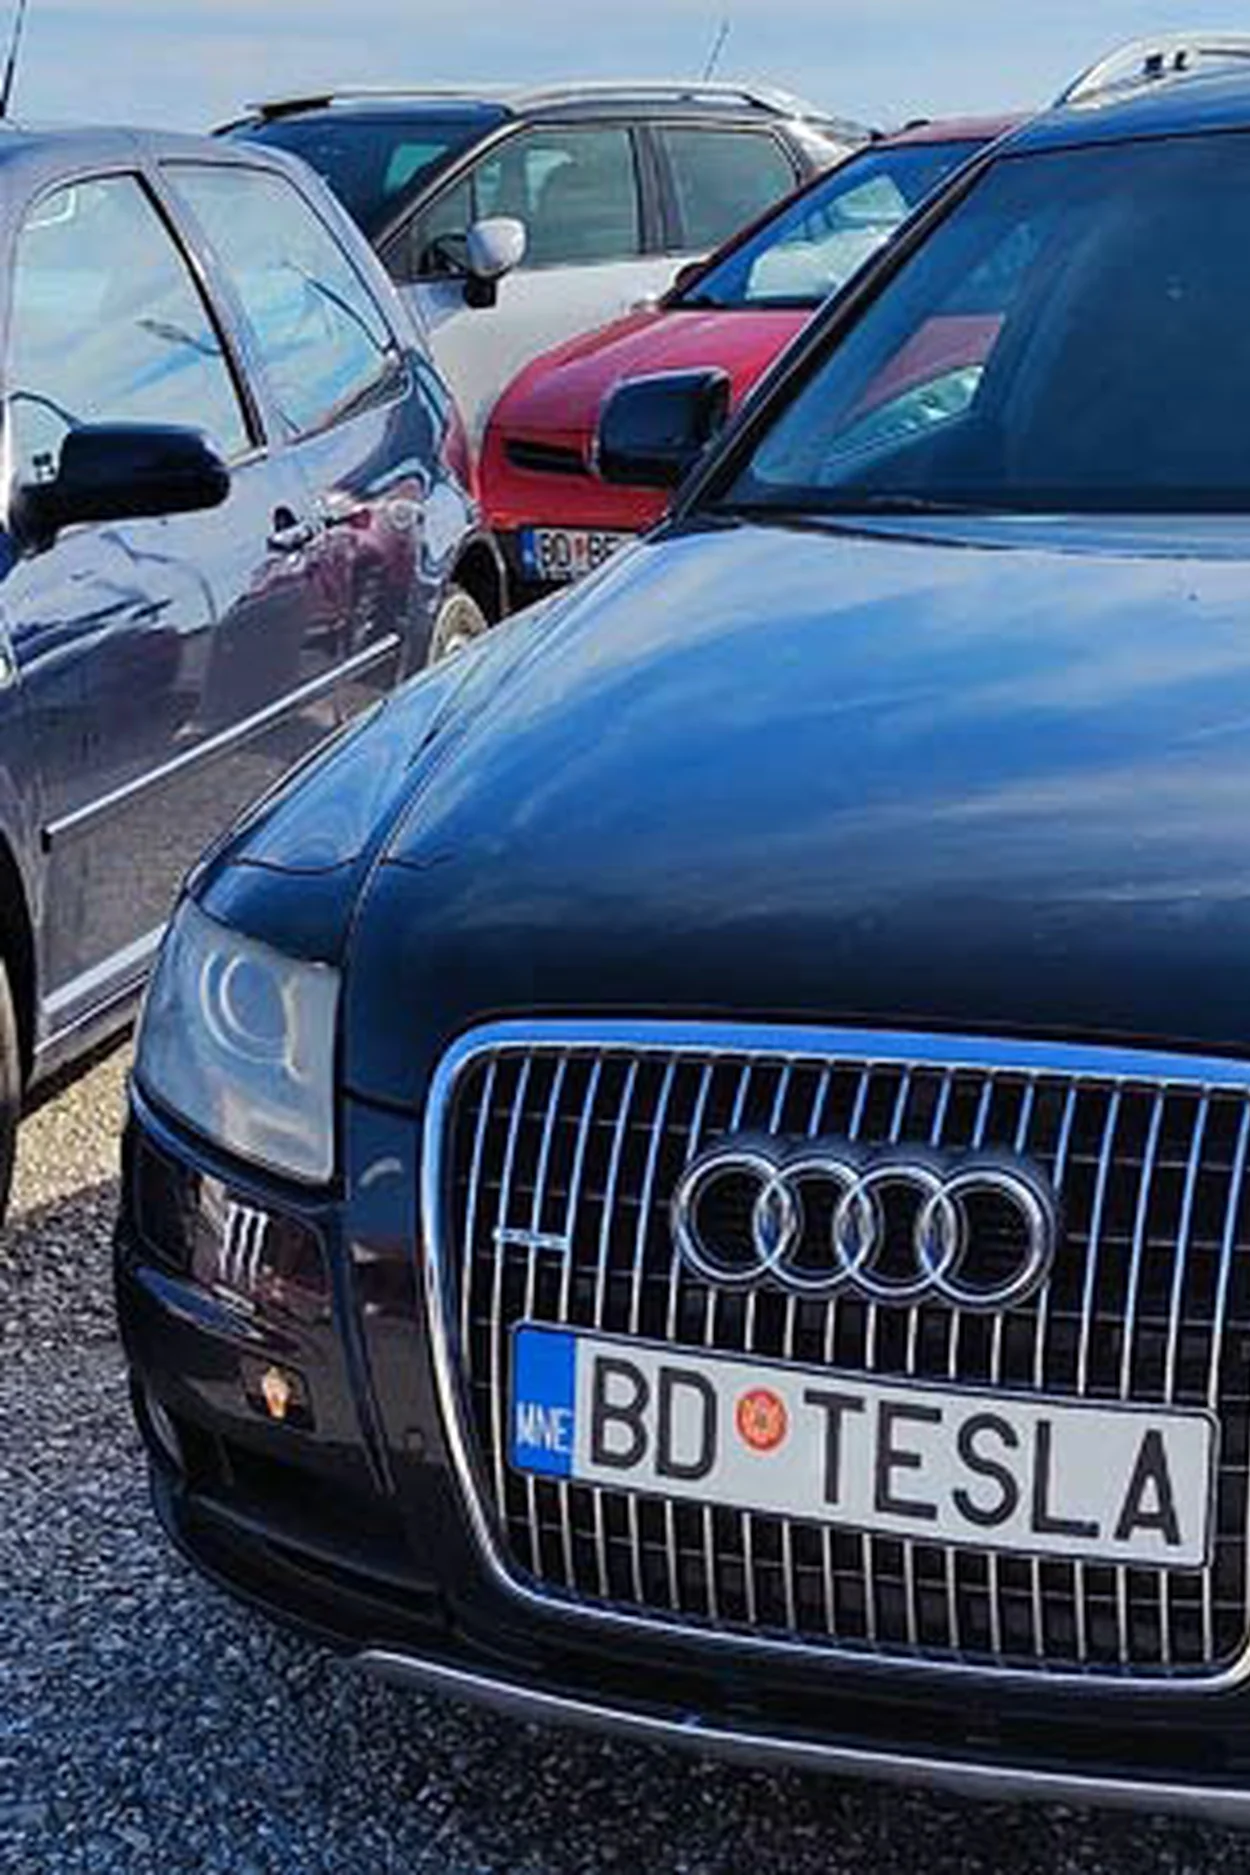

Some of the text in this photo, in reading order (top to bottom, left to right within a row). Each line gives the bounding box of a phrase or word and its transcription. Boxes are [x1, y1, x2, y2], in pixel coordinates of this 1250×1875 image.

[516, 1401, 571, 1453] MNE
[589, 1357, 1182, 1546] BD TESLA
